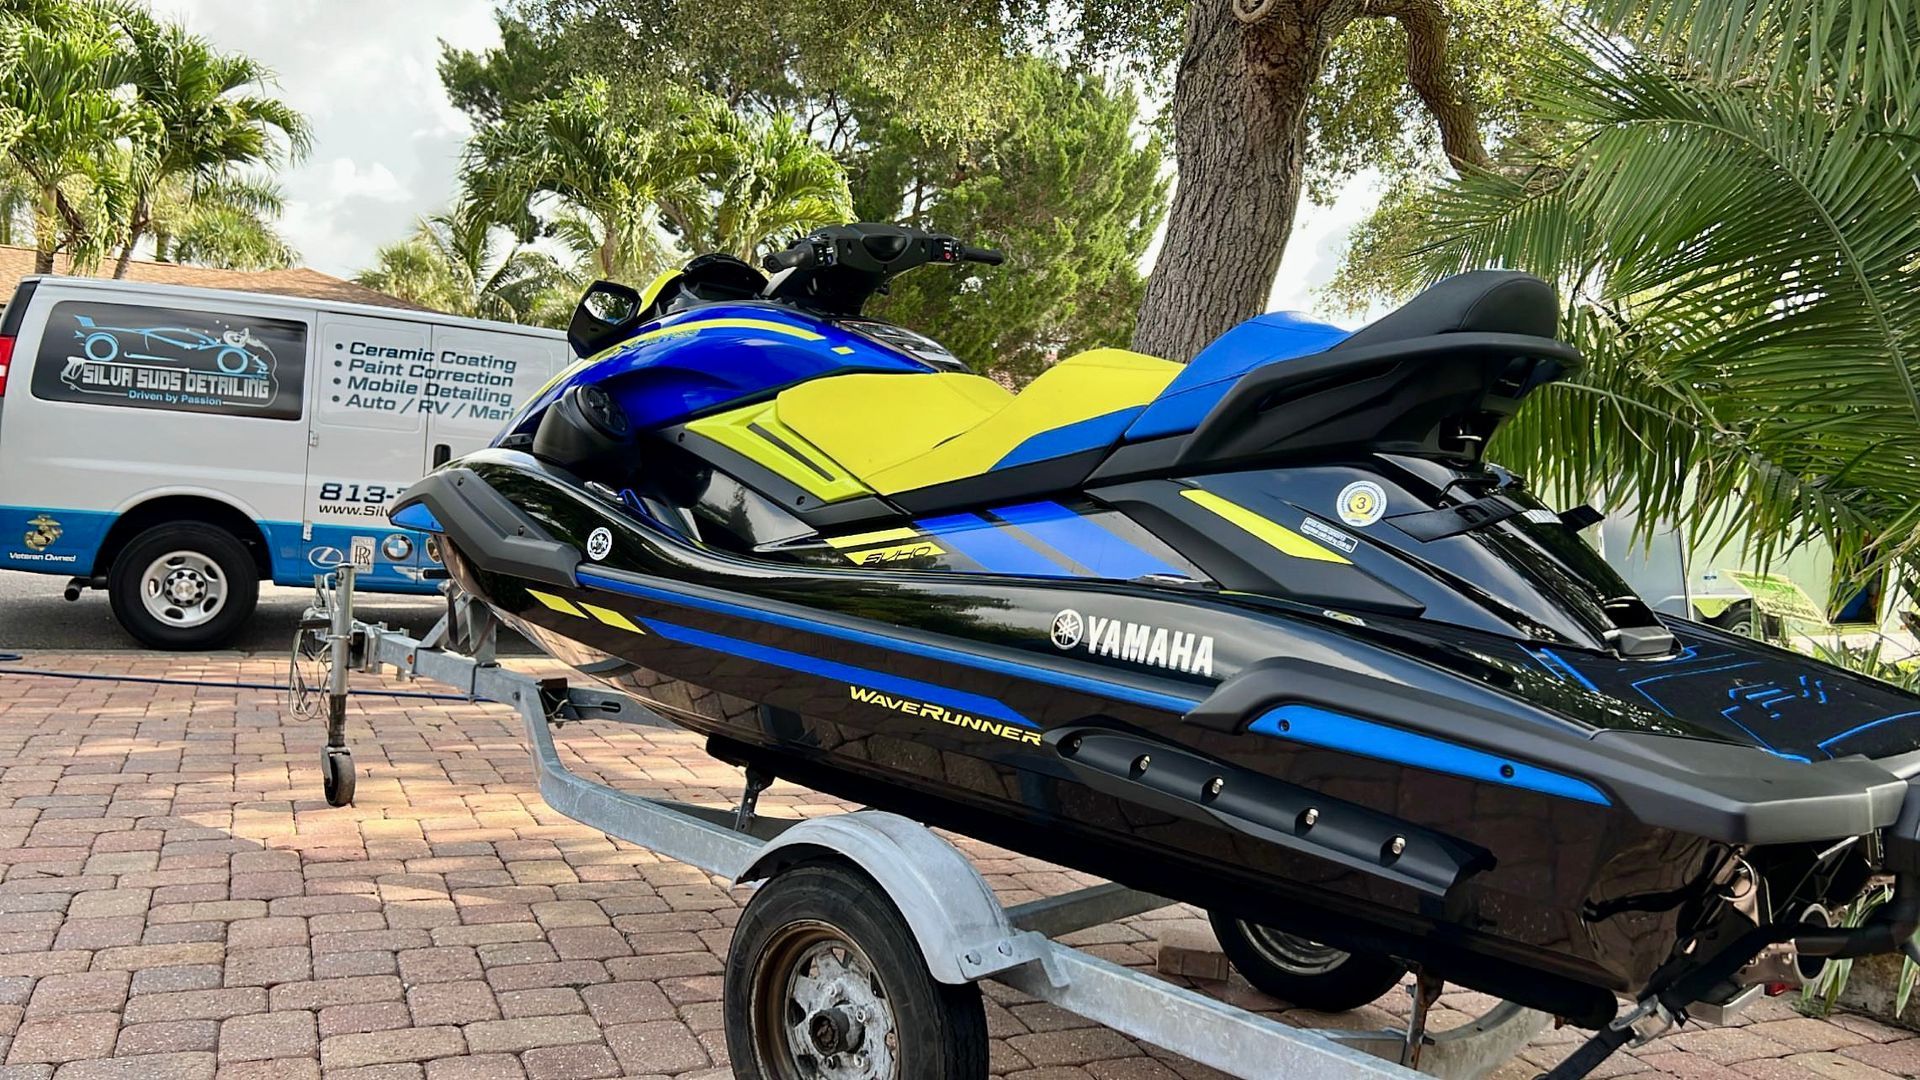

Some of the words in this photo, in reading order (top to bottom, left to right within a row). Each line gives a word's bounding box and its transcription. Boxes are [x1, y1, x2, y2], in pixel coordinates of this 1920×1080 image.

[350, 341, 435, 362] Ceramic
[440, 351, 517, 373] Coating
[82, 364, 133, 387] SILVA
[136, 369, 182, 391] SUDS
[185, 373, 270, 399] DETAILING
[348, 359, 404, 377] Paint
[409, 365, 514, 387] Correction
[128, 389, 163, 402] Driven
[165, 391, 179, 404] by
[181, 394, 222, 407] Passion
[345, 393, 396, 412] Auto
[418, 400, 450, 416] RV
[347, 376, 418, 395] Mobile
[424, 383, 512, 407] Detailing
[1356, 496, 1367, 509] 3
[9, 552, 43, 561] Veteran
[44, 553, 77, 562] Owned
[1087, 615, 1214, 677] YAMAHA
[849, 685, 1042, 747] WAVERUNNER
